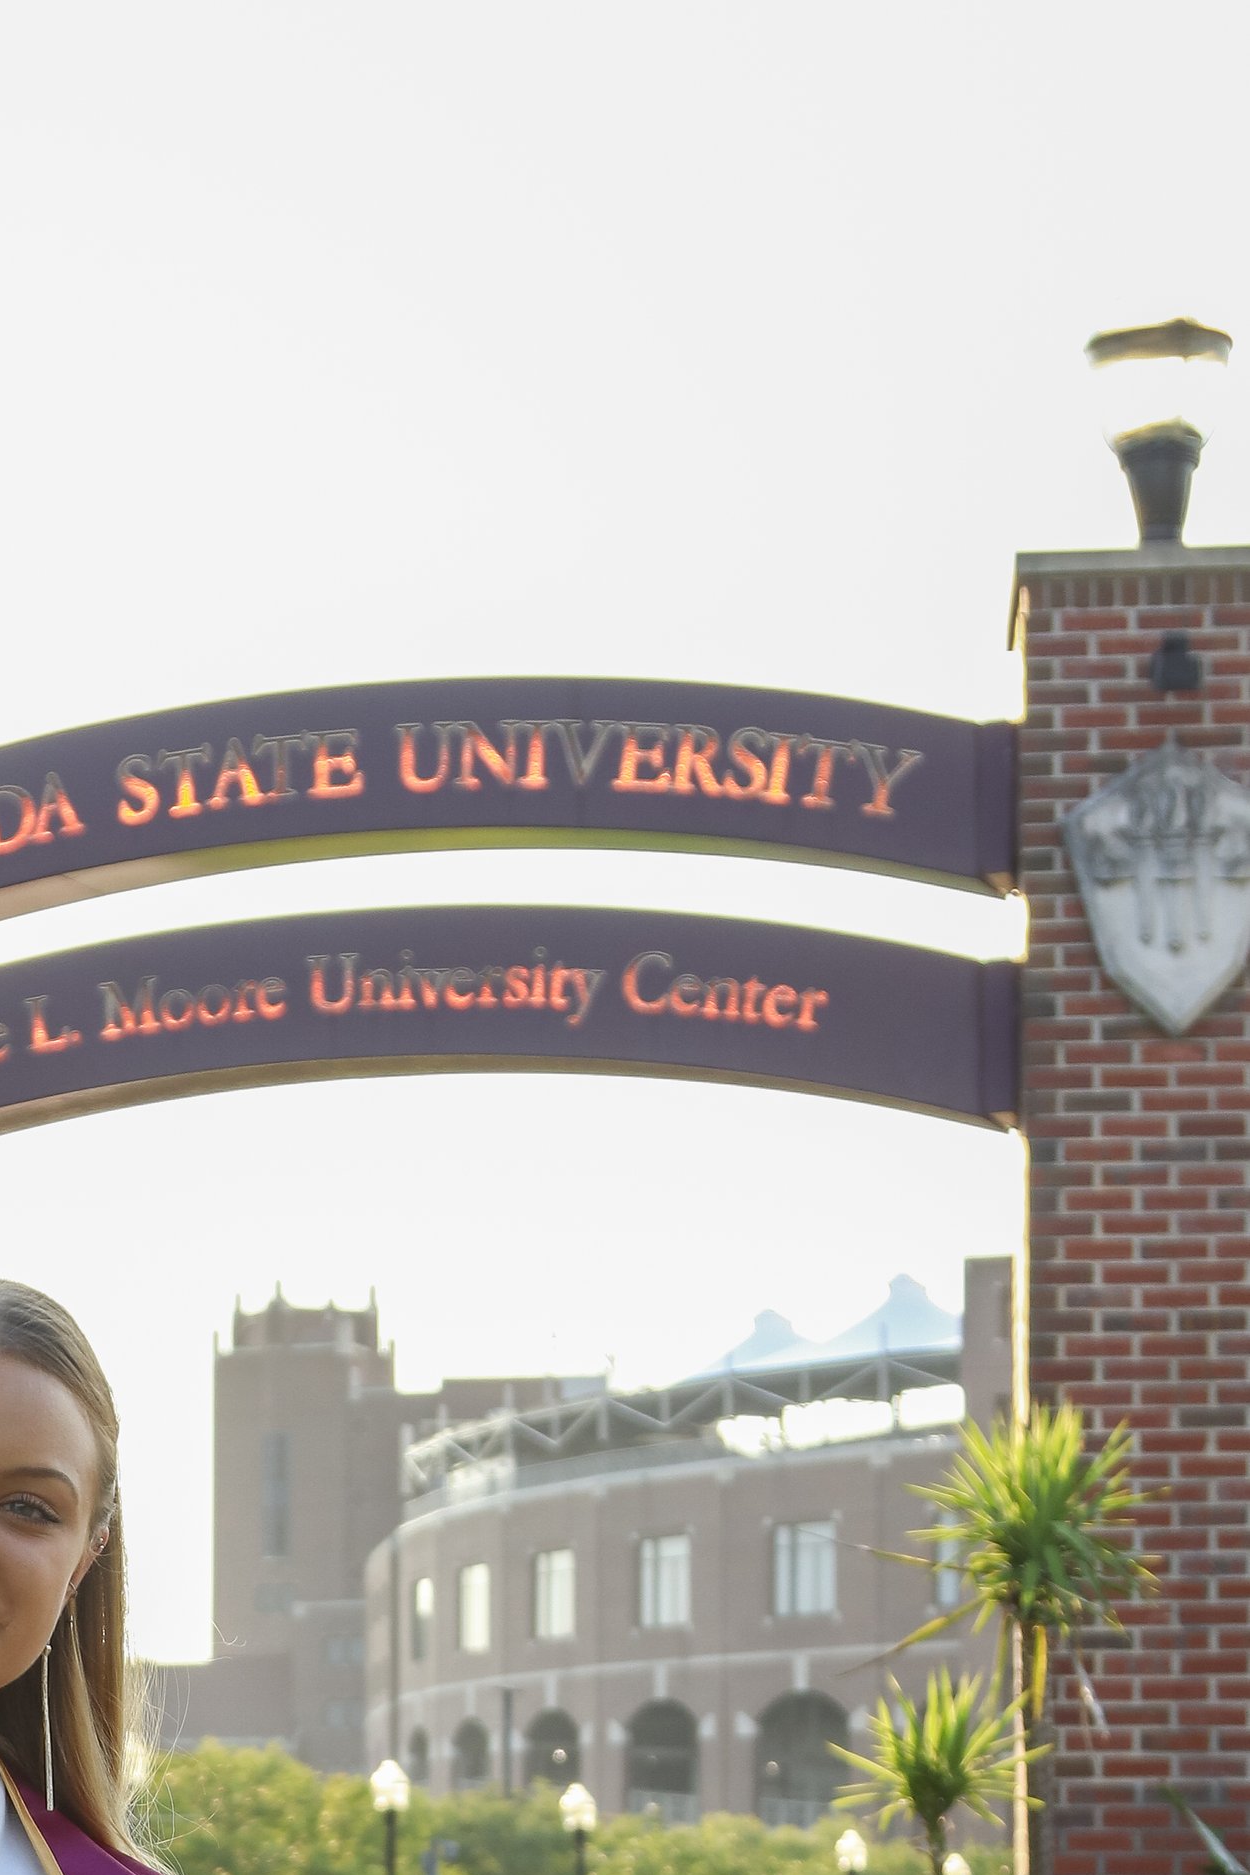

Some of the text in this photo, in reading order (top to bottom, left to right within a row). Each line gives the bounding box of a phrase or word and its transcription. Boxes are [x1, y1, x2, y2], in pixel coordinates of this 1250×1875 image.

[114, 728, 367, 828] STATE
[395, 718, 923, 818] UNIVERSITY
[24, 995, 84, 1055] L.
[99, 975, 286, 1042] Moore
[306, 946, 605, 1030] University
[621, 951, 830, 1032] Center
